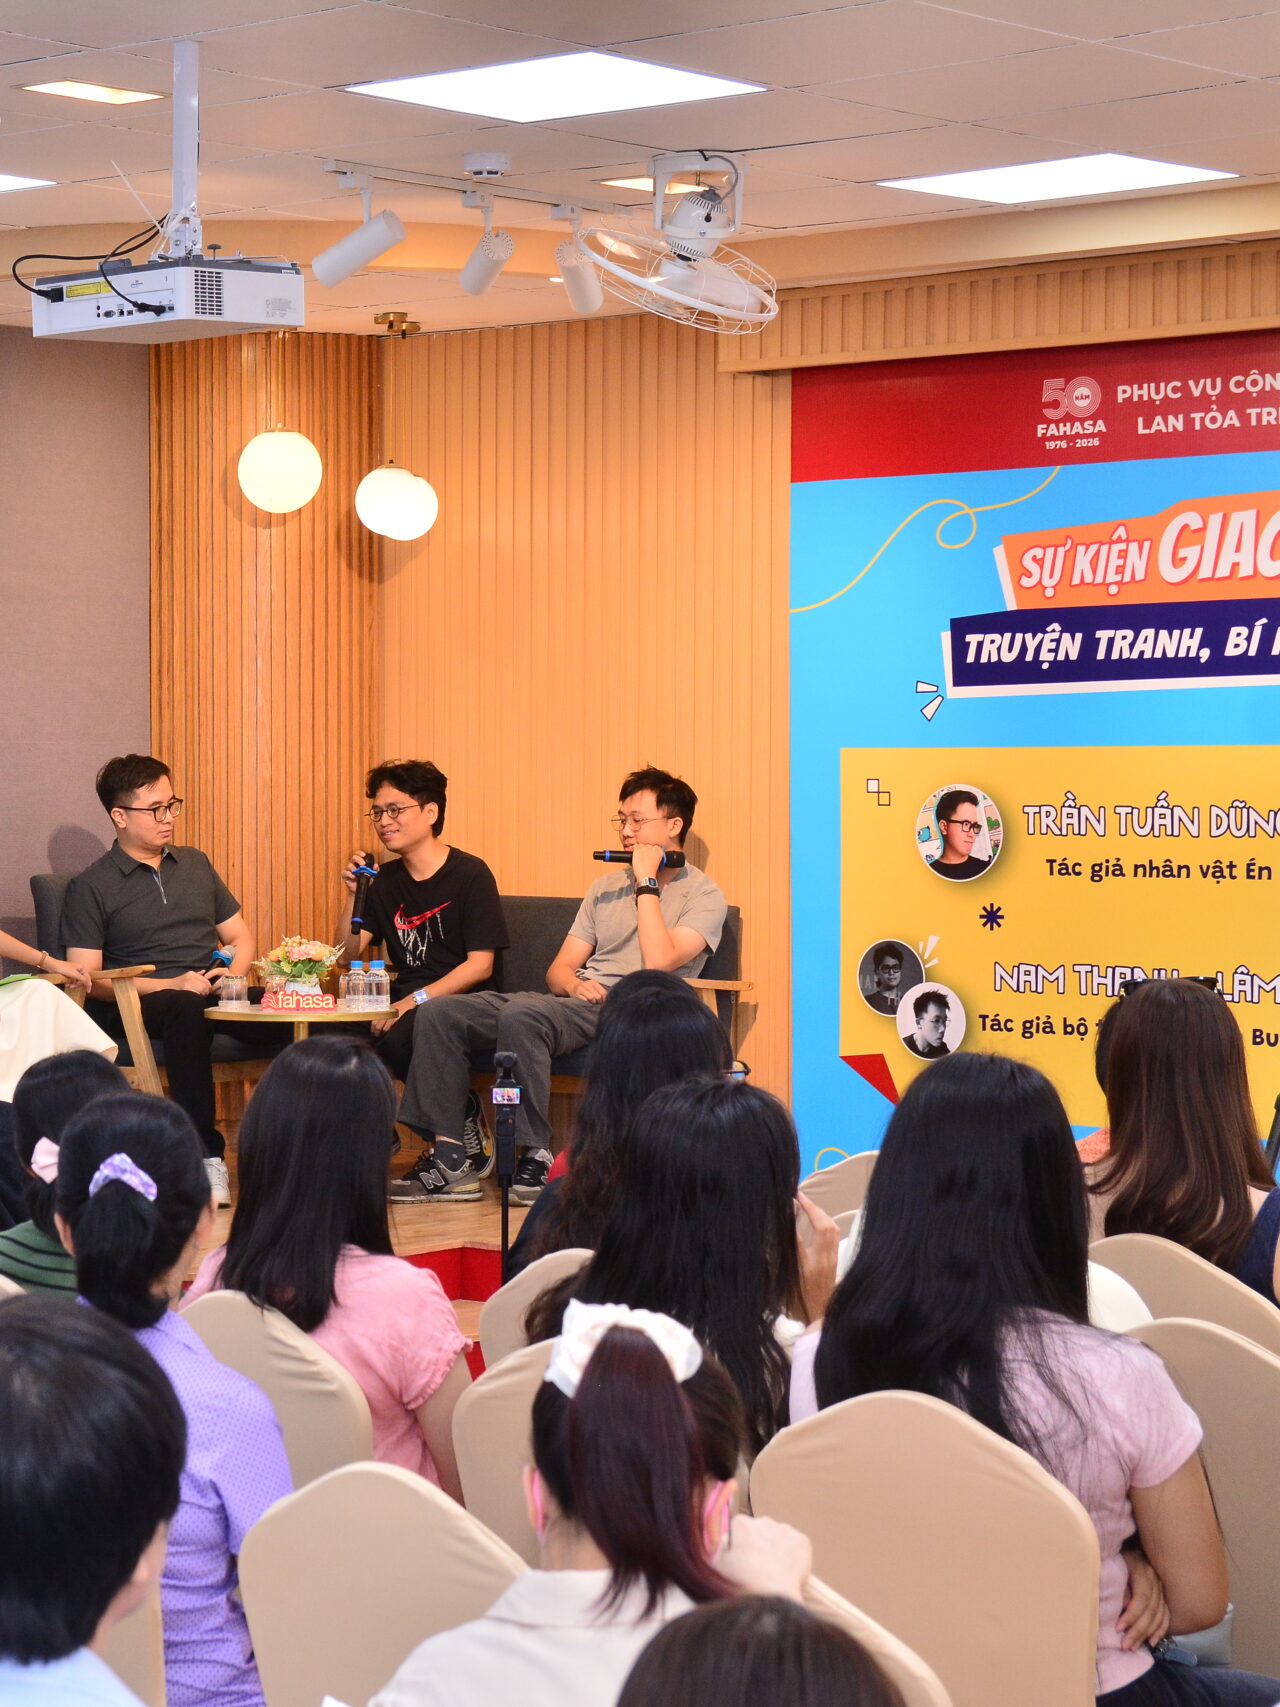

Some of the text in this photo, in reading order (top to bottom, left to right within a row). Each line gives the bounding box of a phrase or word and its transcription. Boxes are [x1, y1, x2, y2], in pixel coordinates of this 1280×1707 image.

[1042, 376, 1101, 419] 50
[1117, 381, 1182, 405] PHỤC
[1188, 377, 1221, 400] VỤ
[1037, 420, 1107, 437] FAHASA
[1137, 414, 1183, 434] LAN
[1190, 405, 1241, 430] TỎA
[1045, 438, 1099, 449] 1976 2026
[1019, 536, 1072, 598] SỰ
[1070, 524, 1152, 596] KIỆN
[965, 623, 1082, 669] TRUYỆN
[1095, 627, 1210, 663] TRANH,
[1224, 617, 1268, 656] BÍ
[1023, 790, 1280, 838] TRẦN TUẤN DŨN
[1046, 858, 1272, 884] Tác giả nhân vật Én
[994, 961, 1065, 995] NAM
[277, 991, 333, 1008] fahasa
[979, 1014, 1013, 1032] Tác
[1021, 1015, 1056, 1040] giả
[1063, 1018, 1088, 1041] bộ
